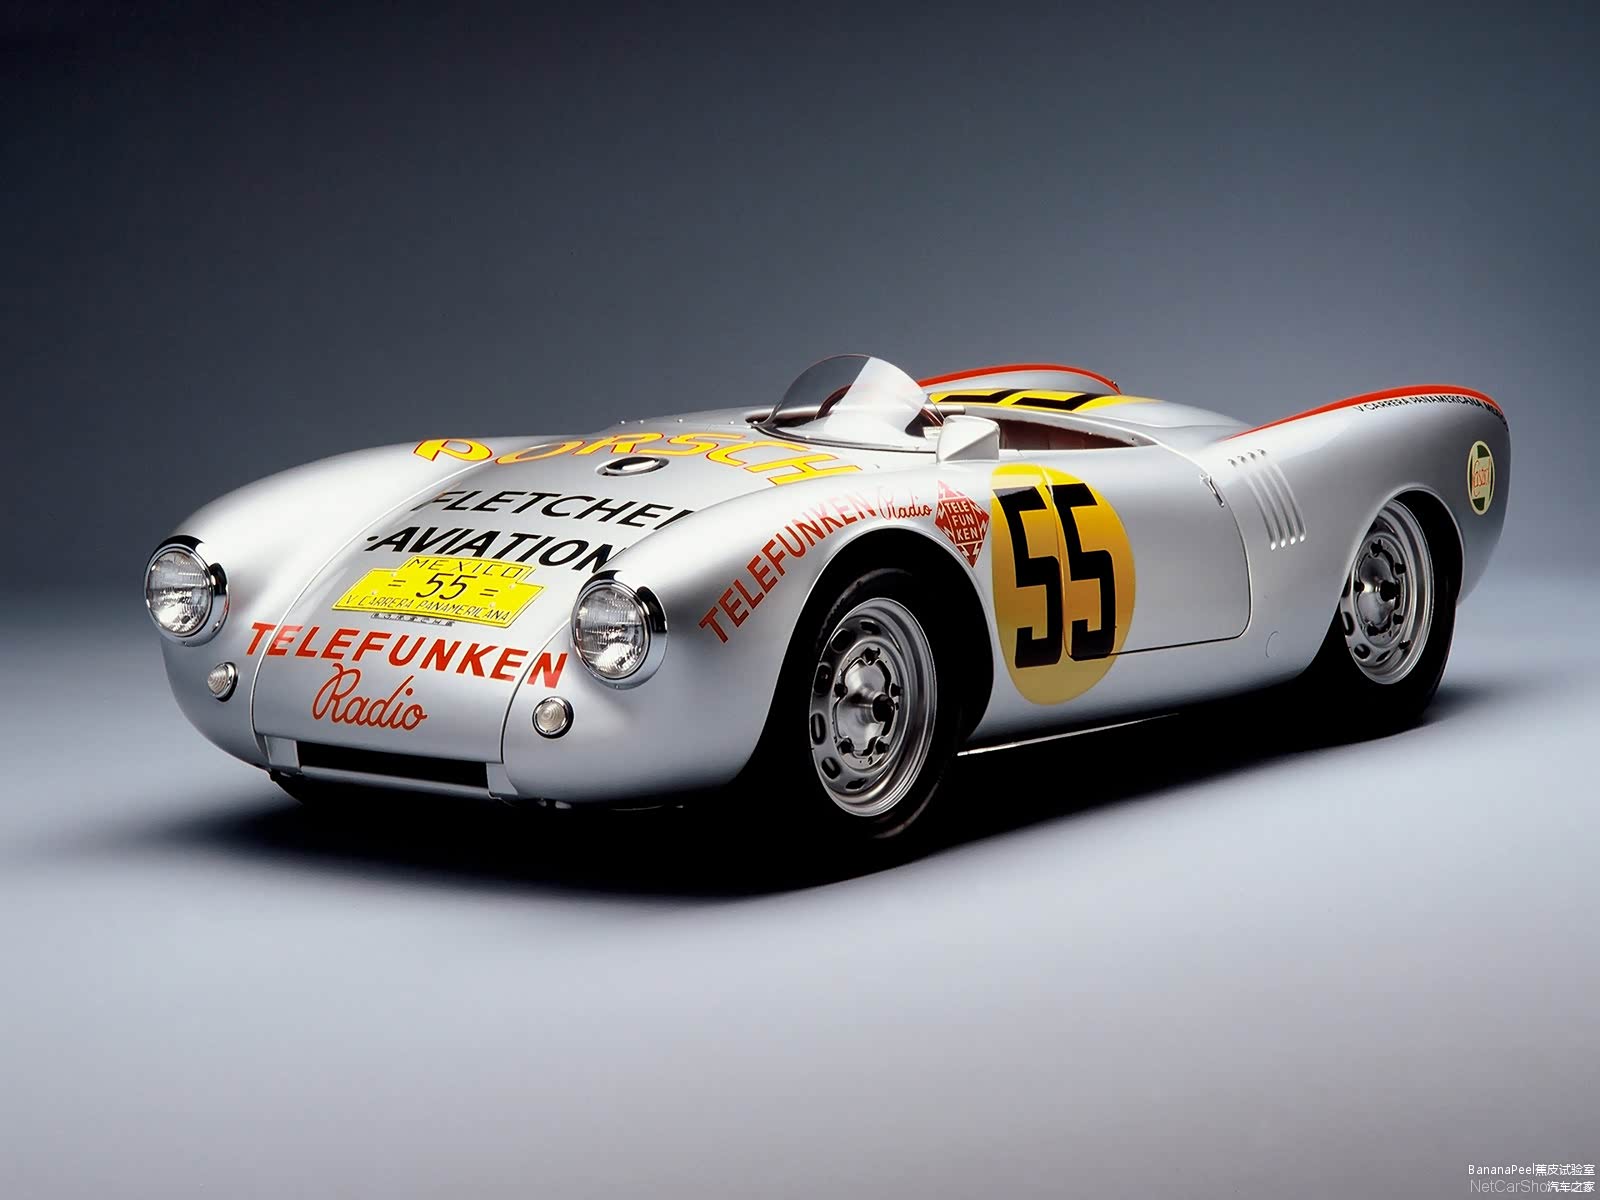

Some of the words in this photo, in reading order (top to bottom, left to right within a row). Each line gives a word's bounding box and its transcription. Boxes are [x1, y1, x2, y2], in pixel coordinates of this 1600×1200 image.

[944, 501, 970, 514] TELE
[951, 514, 975, 527] FUN
[956, 527, 979, 541] KEN
[407, 558, 525, 579] MEXICO
[699, 491, 877, 644] TELEFUNKEN
[876, 487, 932, 521] Radio
[992, 483, 1117, 668] 55
[415, 572, 478, 600] 55
[360, 596, 415, 609] CARRERA
[417, 600, 511, 622] PANAMERICANA
[245, 622, 568, 690] TELEFUNKEN
[312, 663, 428, 732] Radio
